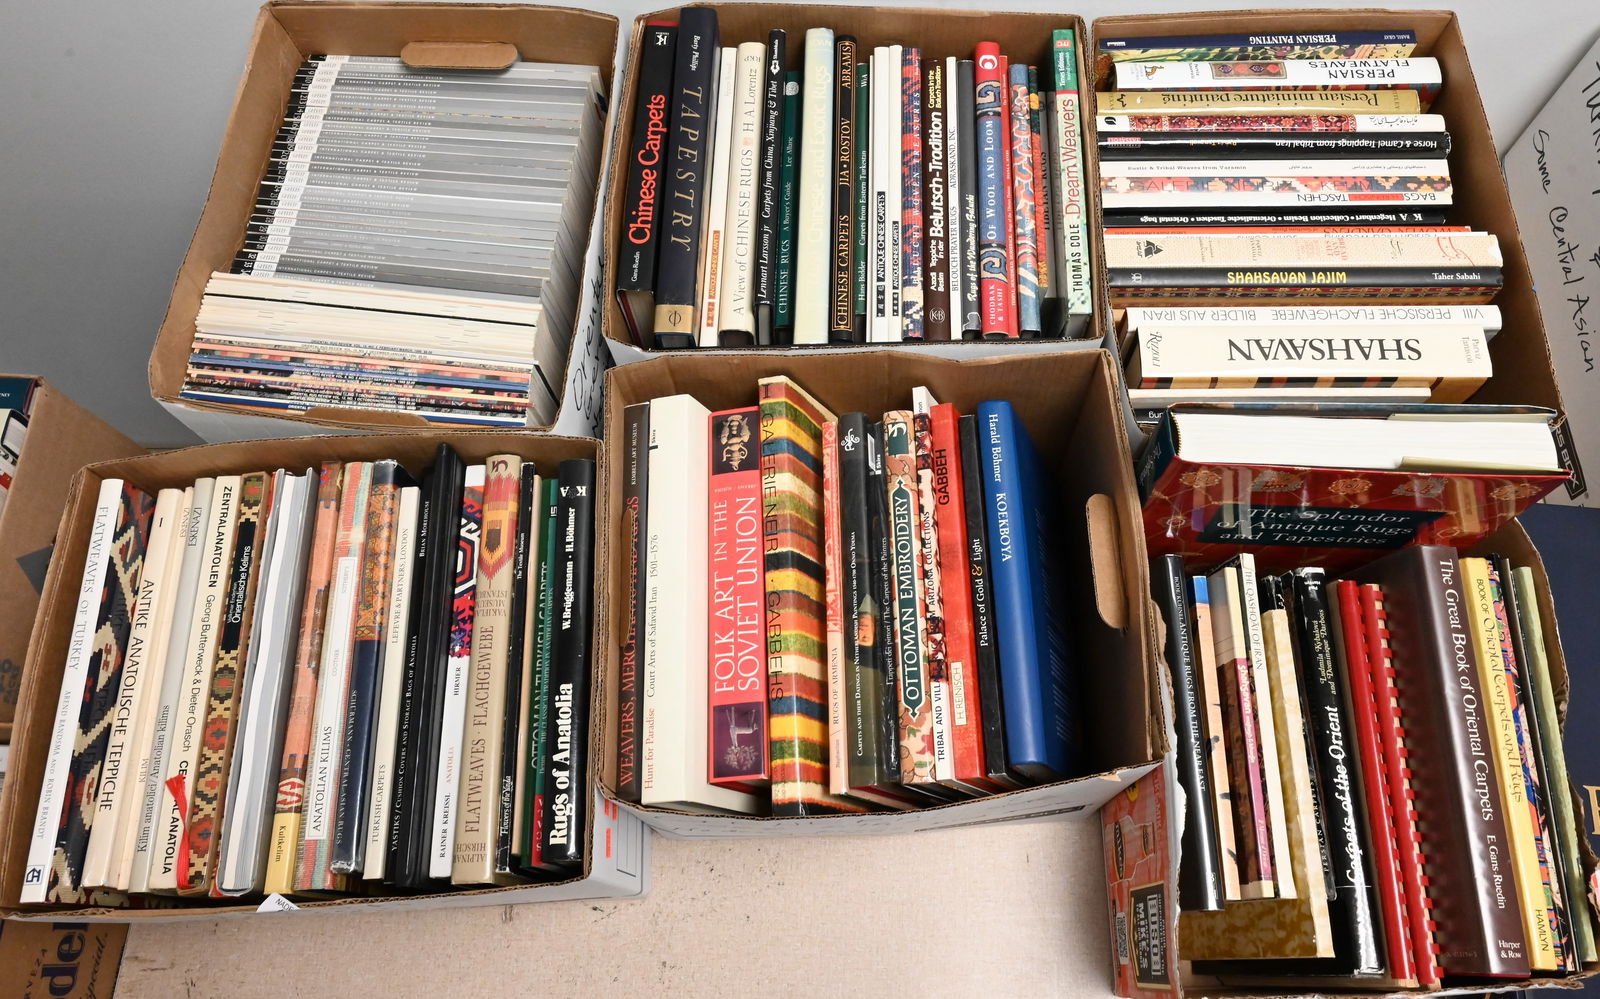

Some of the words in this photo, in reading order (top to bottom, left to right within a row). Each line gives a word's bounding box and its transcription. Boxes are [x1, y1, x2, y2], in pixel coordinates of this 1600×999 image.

[1248, 34, 1294, 45] PAINTING
[1295, 33, 1337, 44] PERSIAN
[841, 45, 853, 90] ABRAMS
[1308, 59, 1409, 68] FLATWEAVES
[1328, 68, 1394, 78] PERSIAN
[743, 68, 757, 104] Lorentz
[768, 80, 777, 98] Tibet
[1161, 92, 1230, 106] painting
[1233, 93, 1313, 105] miniature
[1318, 92, 1378, 105] Persian
[767, 99, 776, 108] &
[637, 94, 666, 164] Carpets
[765, 109, 778, 142] Xinjiang
[839, 115, 851, 164] ROSTOV
[1058, 97, 1078, 162] Weavers
[668, 84, 704, 252] TAPESTRY
[739, 149, 752, 186] RUGS
[839, 168, 850, 187] JIA
[927, 111, 943, 237] Belutsch-Tradition
[1532, 129, 1551, 195] Some
[762, 170, 774, 190] from
[1061, 163, 1081, 216] Dream
[628, 168, 656, 242] Chinese
[761, 189, 773, 218] Carpets
[735, 191, 750, 256] CHINESE
[837, 213, 849, 268] CARPETS
[1068, 222, 1080, 248] COLE
[759, 233, 769, 263] Larsson
[928, 238, 938, 268] Teppiche
[937, 239, 945, 250] der
[734, 259, 746, 271] of
[757, 265, 767, 298] Lennart
[937, 270, 945, 292] Besim
[1069, 250, 1083, 292] THOMAS
[1225, 270, 1307, 285] SHAHSAVAN
[1309, 270, 1348, 284] JAJIM
[1430, 269, 1454, 280] Taher
[1454, 269, 1482, 280] Sabahi
[732, 275, 745, 301] View
[836, 269, 848, 325] CHINESE
[1142, 310, 1175, 320] IRAN
[1179, 309, 1206, 320] AUS
[1211, 309, 1256, 320] BILDER
[1270, 308, 1374, 320] FLACHGEWEBE
[1378, 308, 1451, 319] PERSISCHE
[1462, 308, 1484, 319] VIII
[1227, 338, 1421, 360] SHAHSAVAN
[1567, 295, 1595, 373] Asian
[986, 413, 1000, 443] Harald
[760, 411, 777, 499] GALERIE
[989, 445, 1002, 483] Böhmer
[934, 447, 950, 506] GABBEH
[713, 499, 727, 536] THE
[993, 492, 1012, 564] KOEKBOYA
[1216, 519, 1243, 528] of
[1248, 521, 1345, 533] Antique
[1352, 524, 1414, 536] Rugs
[1246, 508, 1292, 519] The
[1298, 510, 1411, 523] Splendor
[83, 506, 108, 592] FLATWEAVES
[208, 486, 232, 587] ZENTRALANATOLIEN
[713, 542, 727, 561] IN
[735, 497, 757, 585] UNION
[894, 496, 912, 599] EMBROIDERY
[972, 538, 982, 560] Light
[1219, 531, 1264, 541] and
[1272, 532, 1388, 545] Tapestries
[239, 545, 250, 571] Kelims
[971, 563, 982, 576] &
[1439, 558, 1453, 584] The
[134, 579, 154, 629] ANTIKE
[648, 586, 657, 603] Iran
[714, 571, 734, 620] ART
[974, 578, 984, 601] Gold
[1475, 577, 1488, 602] BOOK
[200, 594, 215, 622] Georg
[647, 605, 656, 636] Safavid
[976, 603, 985, 613] of
[1445, 588, 1461, 628] Great
[68, 620, 86, 669] TURKEY
[736, 595, 759, 690] SOVIET
[765, 589, 783, 704] GABBEHS
[978, 615, 988, 646] Palace
[1482, 615, 1503, 673] Oriental
[194, 623, 210, 676] Butterweck
[647, 649, 655, 667] Arts
[714, 629, 734, 692] FOLK
[901, 608, 919, 699] OTTOMAN
[1451, 633, 1469, 672] Book
[113, 636, 143, 736] ANATOLISCHE
[473, 625, 494, 727] FLACHGEWEBE
[646, 670, 655, 697] Court
[1459, 675, 1474, 692] of
[188, 687, 200, 714] Dieter
[1489, 672, 1513, 732] Carpets
[182, 716, 196, 752] Orasch
[552, 683, 572, 765] Anatolia
[645, 708, 654, 744] Paradise
[1462, 694, 1485, 755] Oriental
[319, 726, 331, 762] KILIMS
[644, 748, 653, 760] for
[1502, 731, 1517, 760] and
[98, 741, 123, 811] TEPPICHE
[465, 738, 486, 833] FLATWEAVES
[552, 770, 570, 791] of
[644, 764, 653, 789] Hunt
[1473, 759, 1493, 820] Carpets
[1506, 760, 1526, 803] Rugs
[312, 766, 327, 831] ANATOLIAN
[549, 792, 575, 848] Rugs
[162, 816, 179, 874] ANATOLIA
[1488, 845, 1505, 908] Gans-Ruedin
[1535, 909, 1549, 951] HAMLYN
